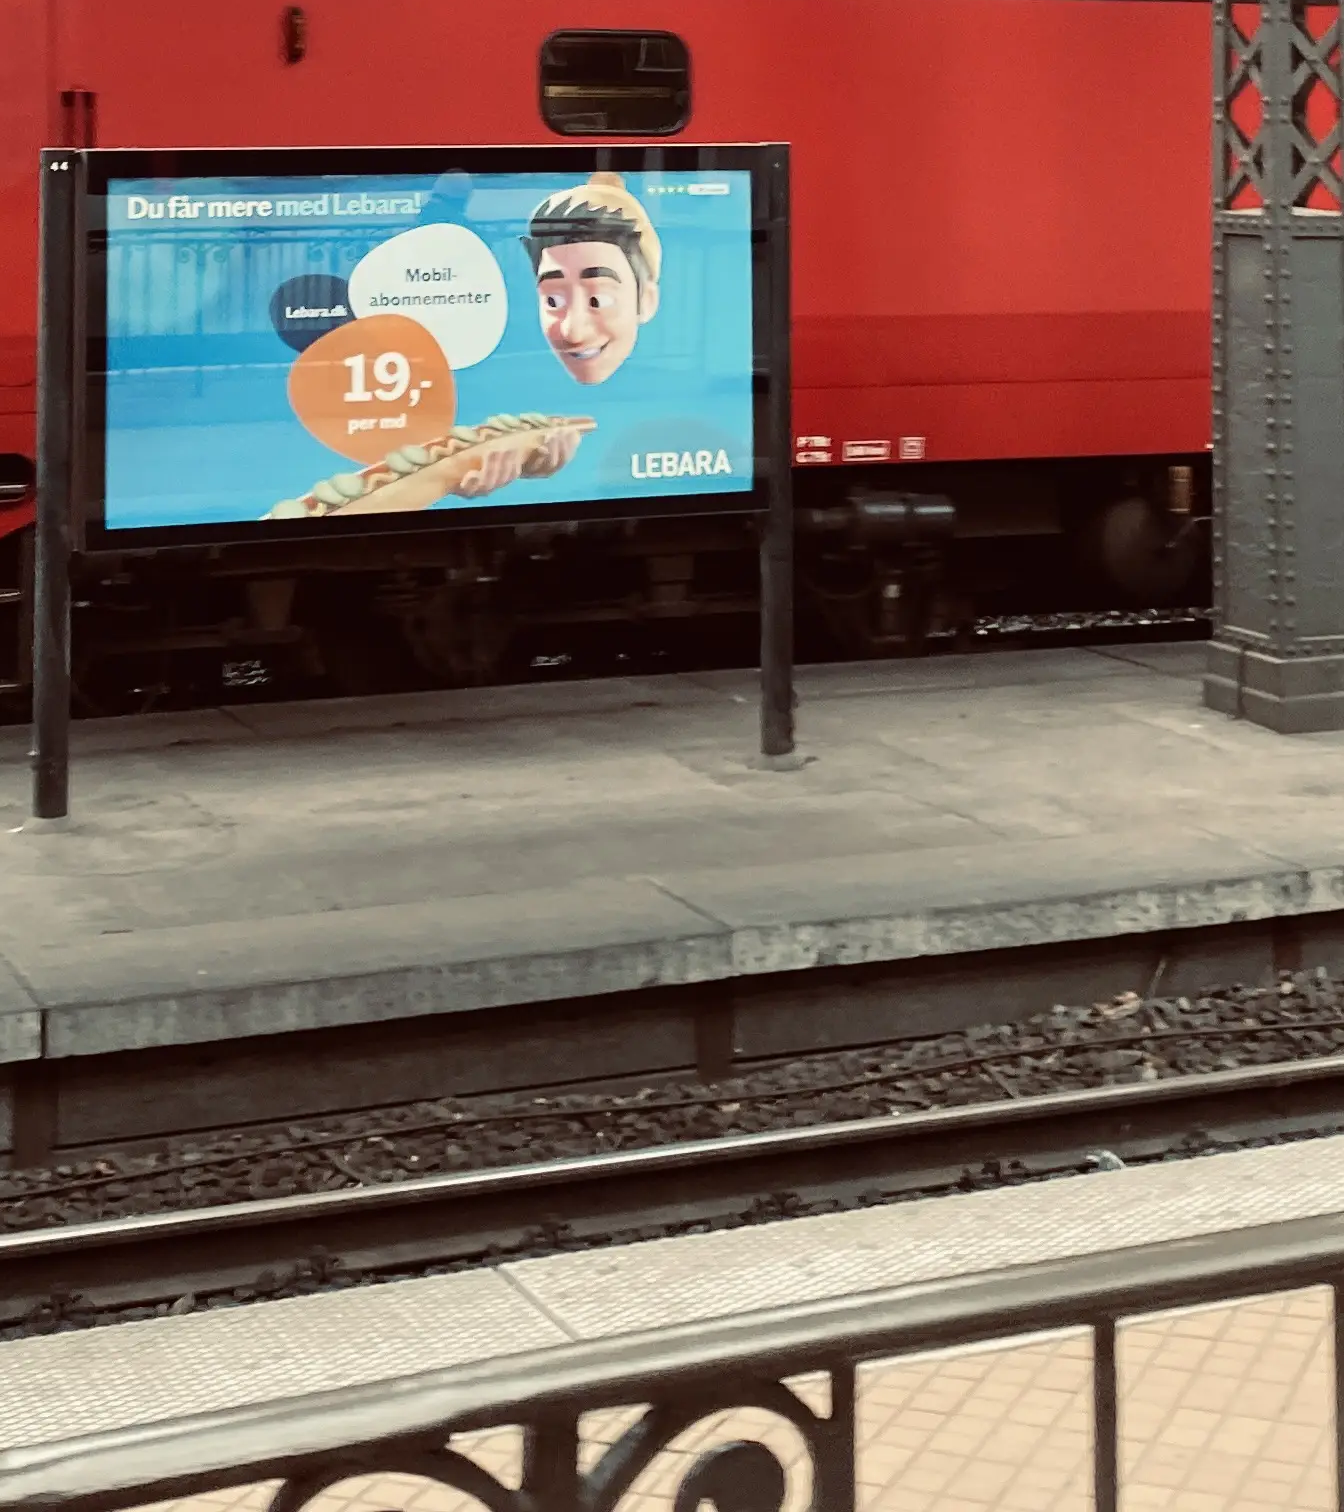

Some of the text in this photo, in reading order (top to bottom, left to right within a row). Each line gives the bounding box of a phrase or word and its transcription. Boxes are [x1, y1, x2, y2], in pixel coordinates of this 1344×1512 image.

[127, 192, 422, 220] Du får mere med Lebara!
[405, 268, 458, 283] Mobil-
[369, 291, 492, 307] abonnementer
[285, 304, 348, 319] Lebara.dk
[343, 351, 433, 407] 19,-
[347, 413, 408, 435] per md
[631, 449, 732, 479] LEBARA
